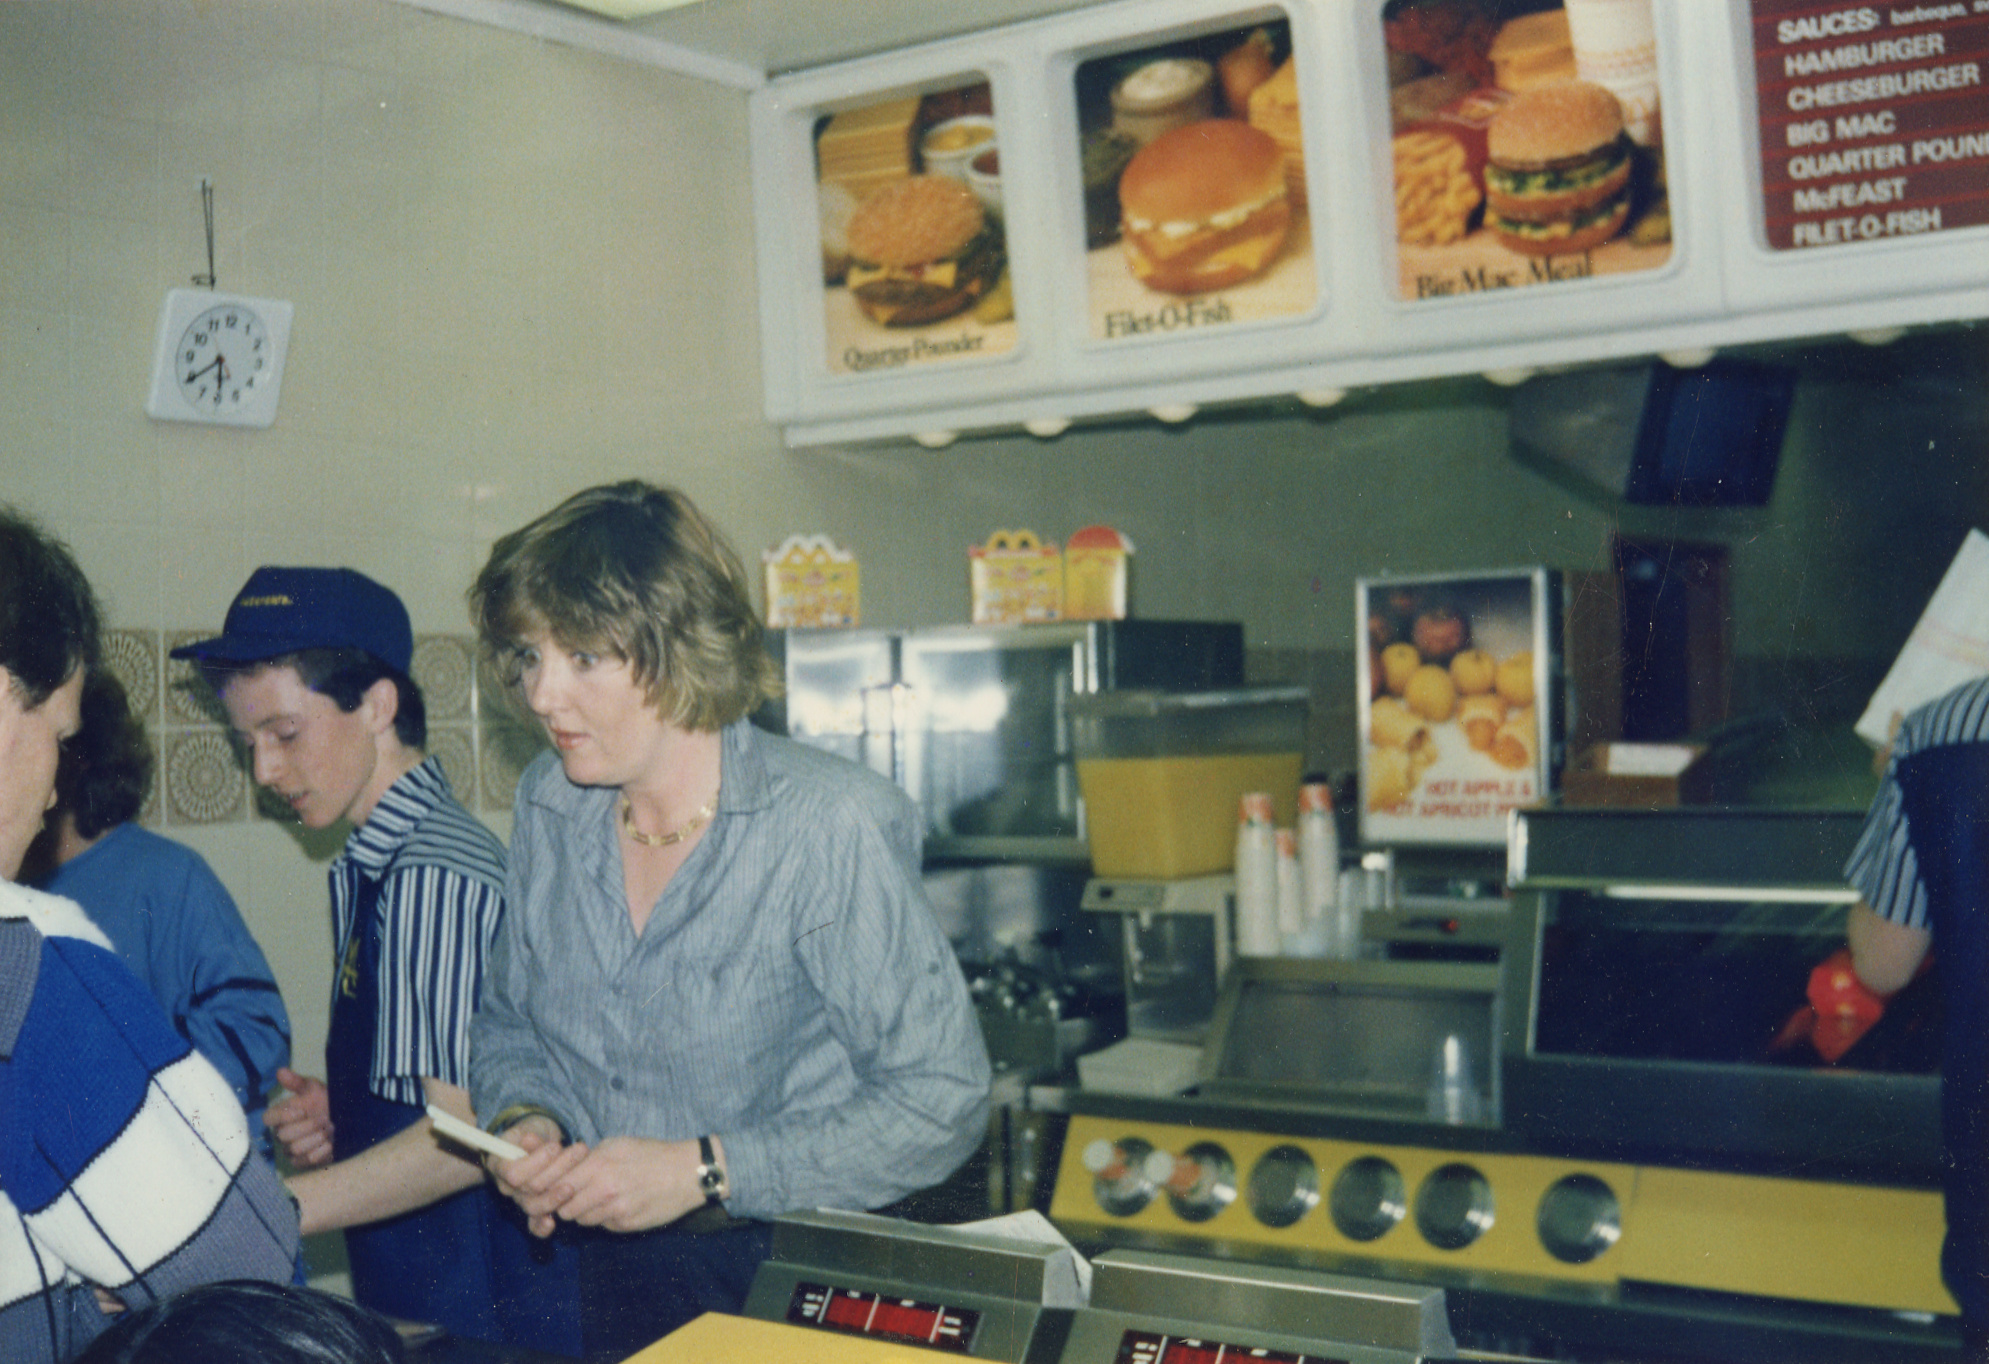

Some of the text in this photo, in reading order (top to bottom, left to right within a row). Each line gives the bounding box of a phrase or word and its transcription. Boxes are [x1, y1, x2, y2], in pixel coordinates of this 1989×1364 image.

[1784, 32, 1945, 77] HAMBURGER
[1787, 62, 1980, 111] CHEESEBURGER
[1786, 110, 1896, 147] BIG MAC
[1788, 132, 1989, 180] QUARTER POUN
[1793, 176, 1908, 213] McFEAST
[1793, 206, 1941, 247] FILET-O-FISH
[208, 319, 219, 332] 11
[225, 315, 238, 329] 12
[1105, 298, 1232, 338] Filet-O-Fish
[194, 332, 208, 347] 10
[844, 330, 983, 372] Quarter Pounder
